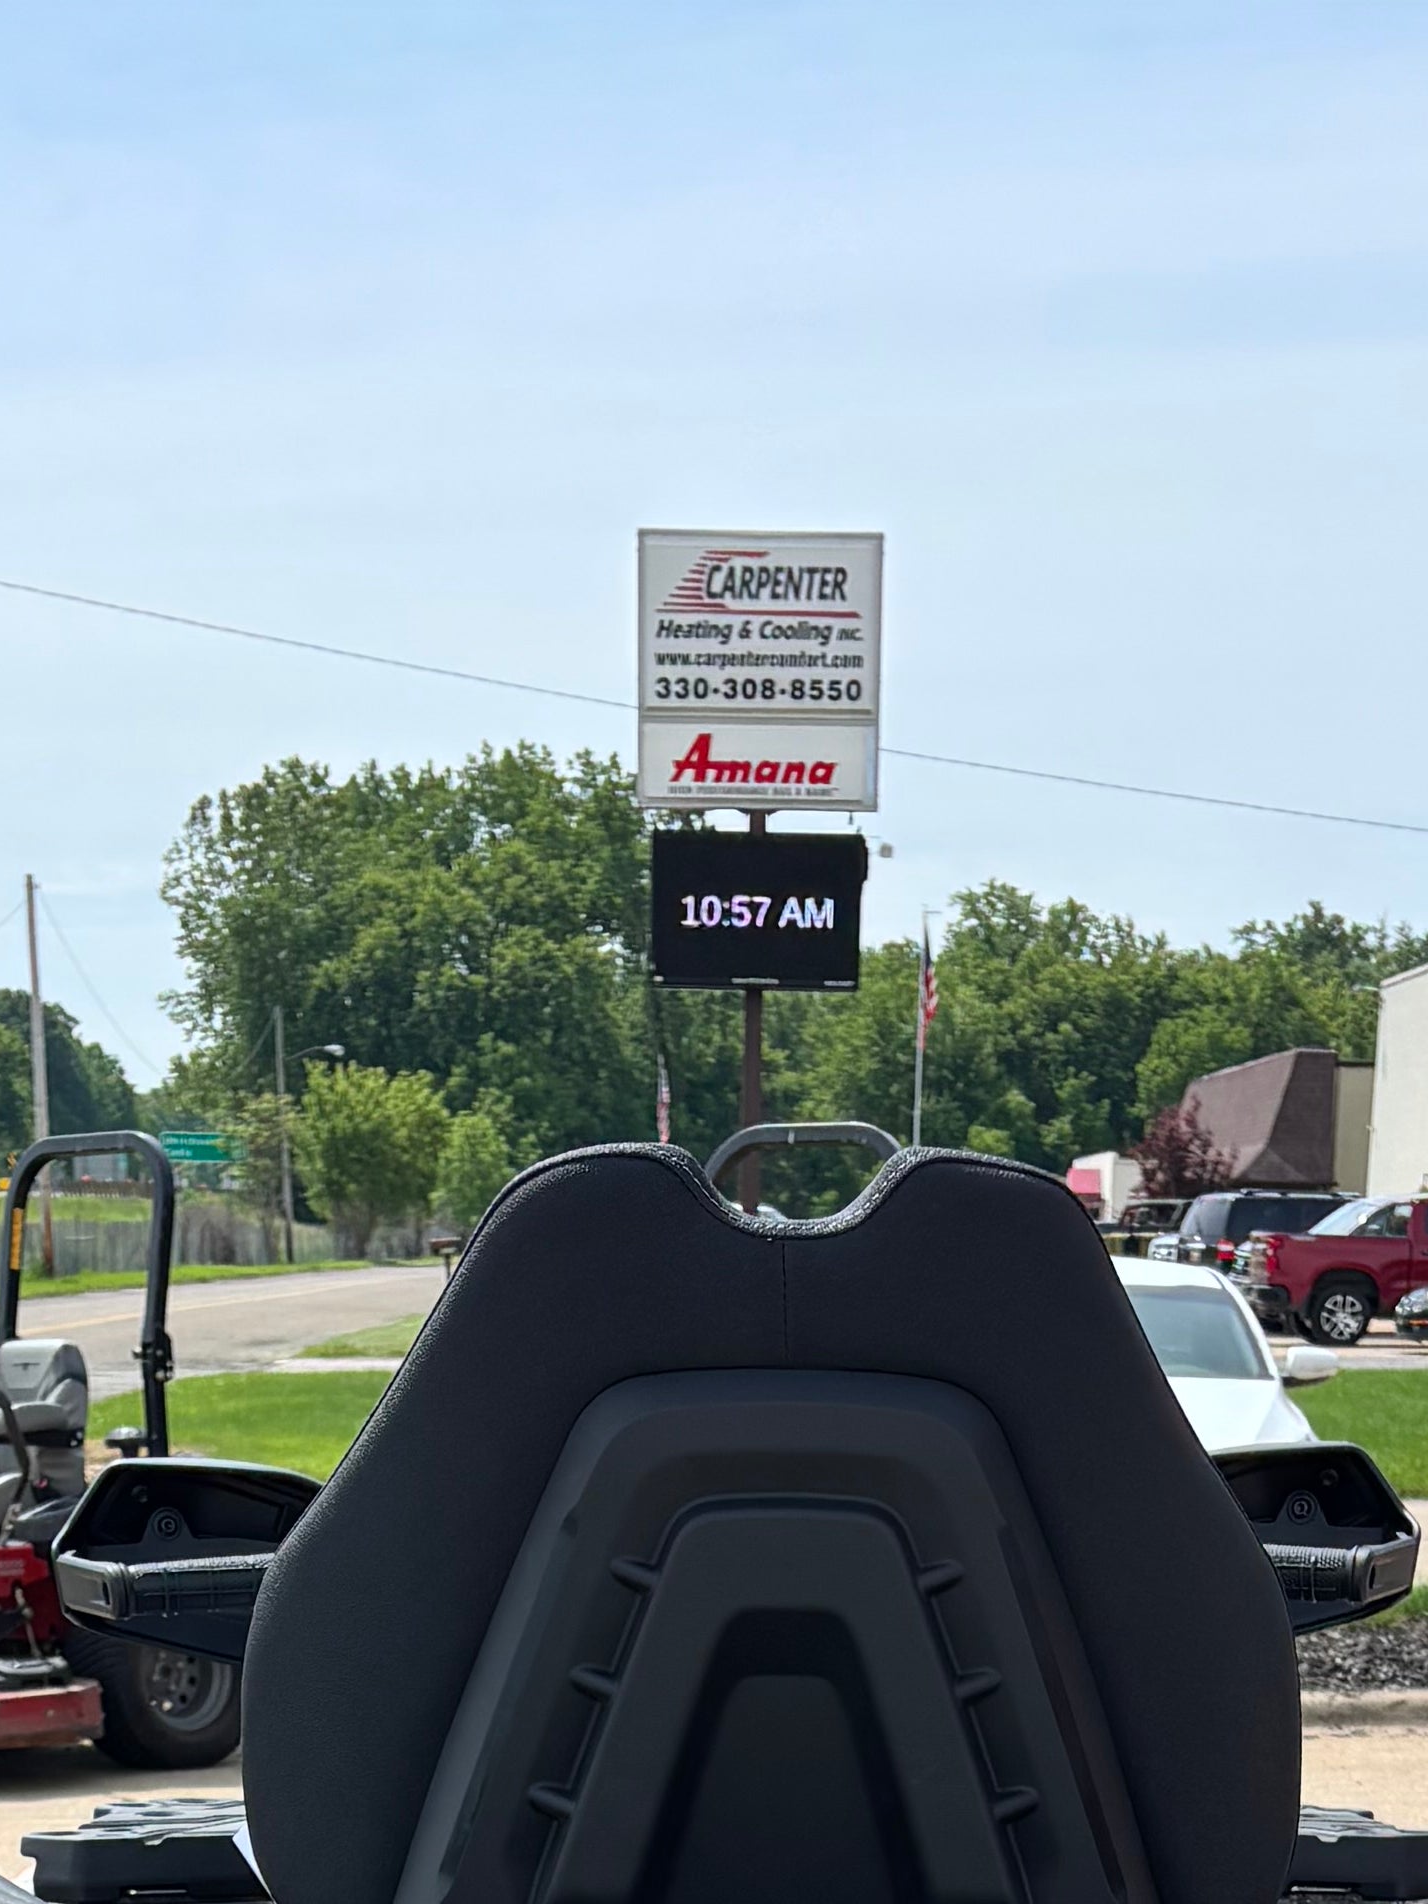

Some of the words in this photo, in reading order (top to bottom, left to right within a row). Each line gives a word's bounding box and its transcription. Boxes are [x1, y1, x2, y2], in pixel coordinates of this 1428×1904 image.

[705, 563, 848, 601] CARPENTER
[655, 618, 734, 645] Heating
[738, 620, 752, 640] &
[759, 620, 834, 647] Cooling
[669, 732, 839, 785] Amana
[680, 894, 772, 929] 10:57
[777, 896, 835, 929] AM
